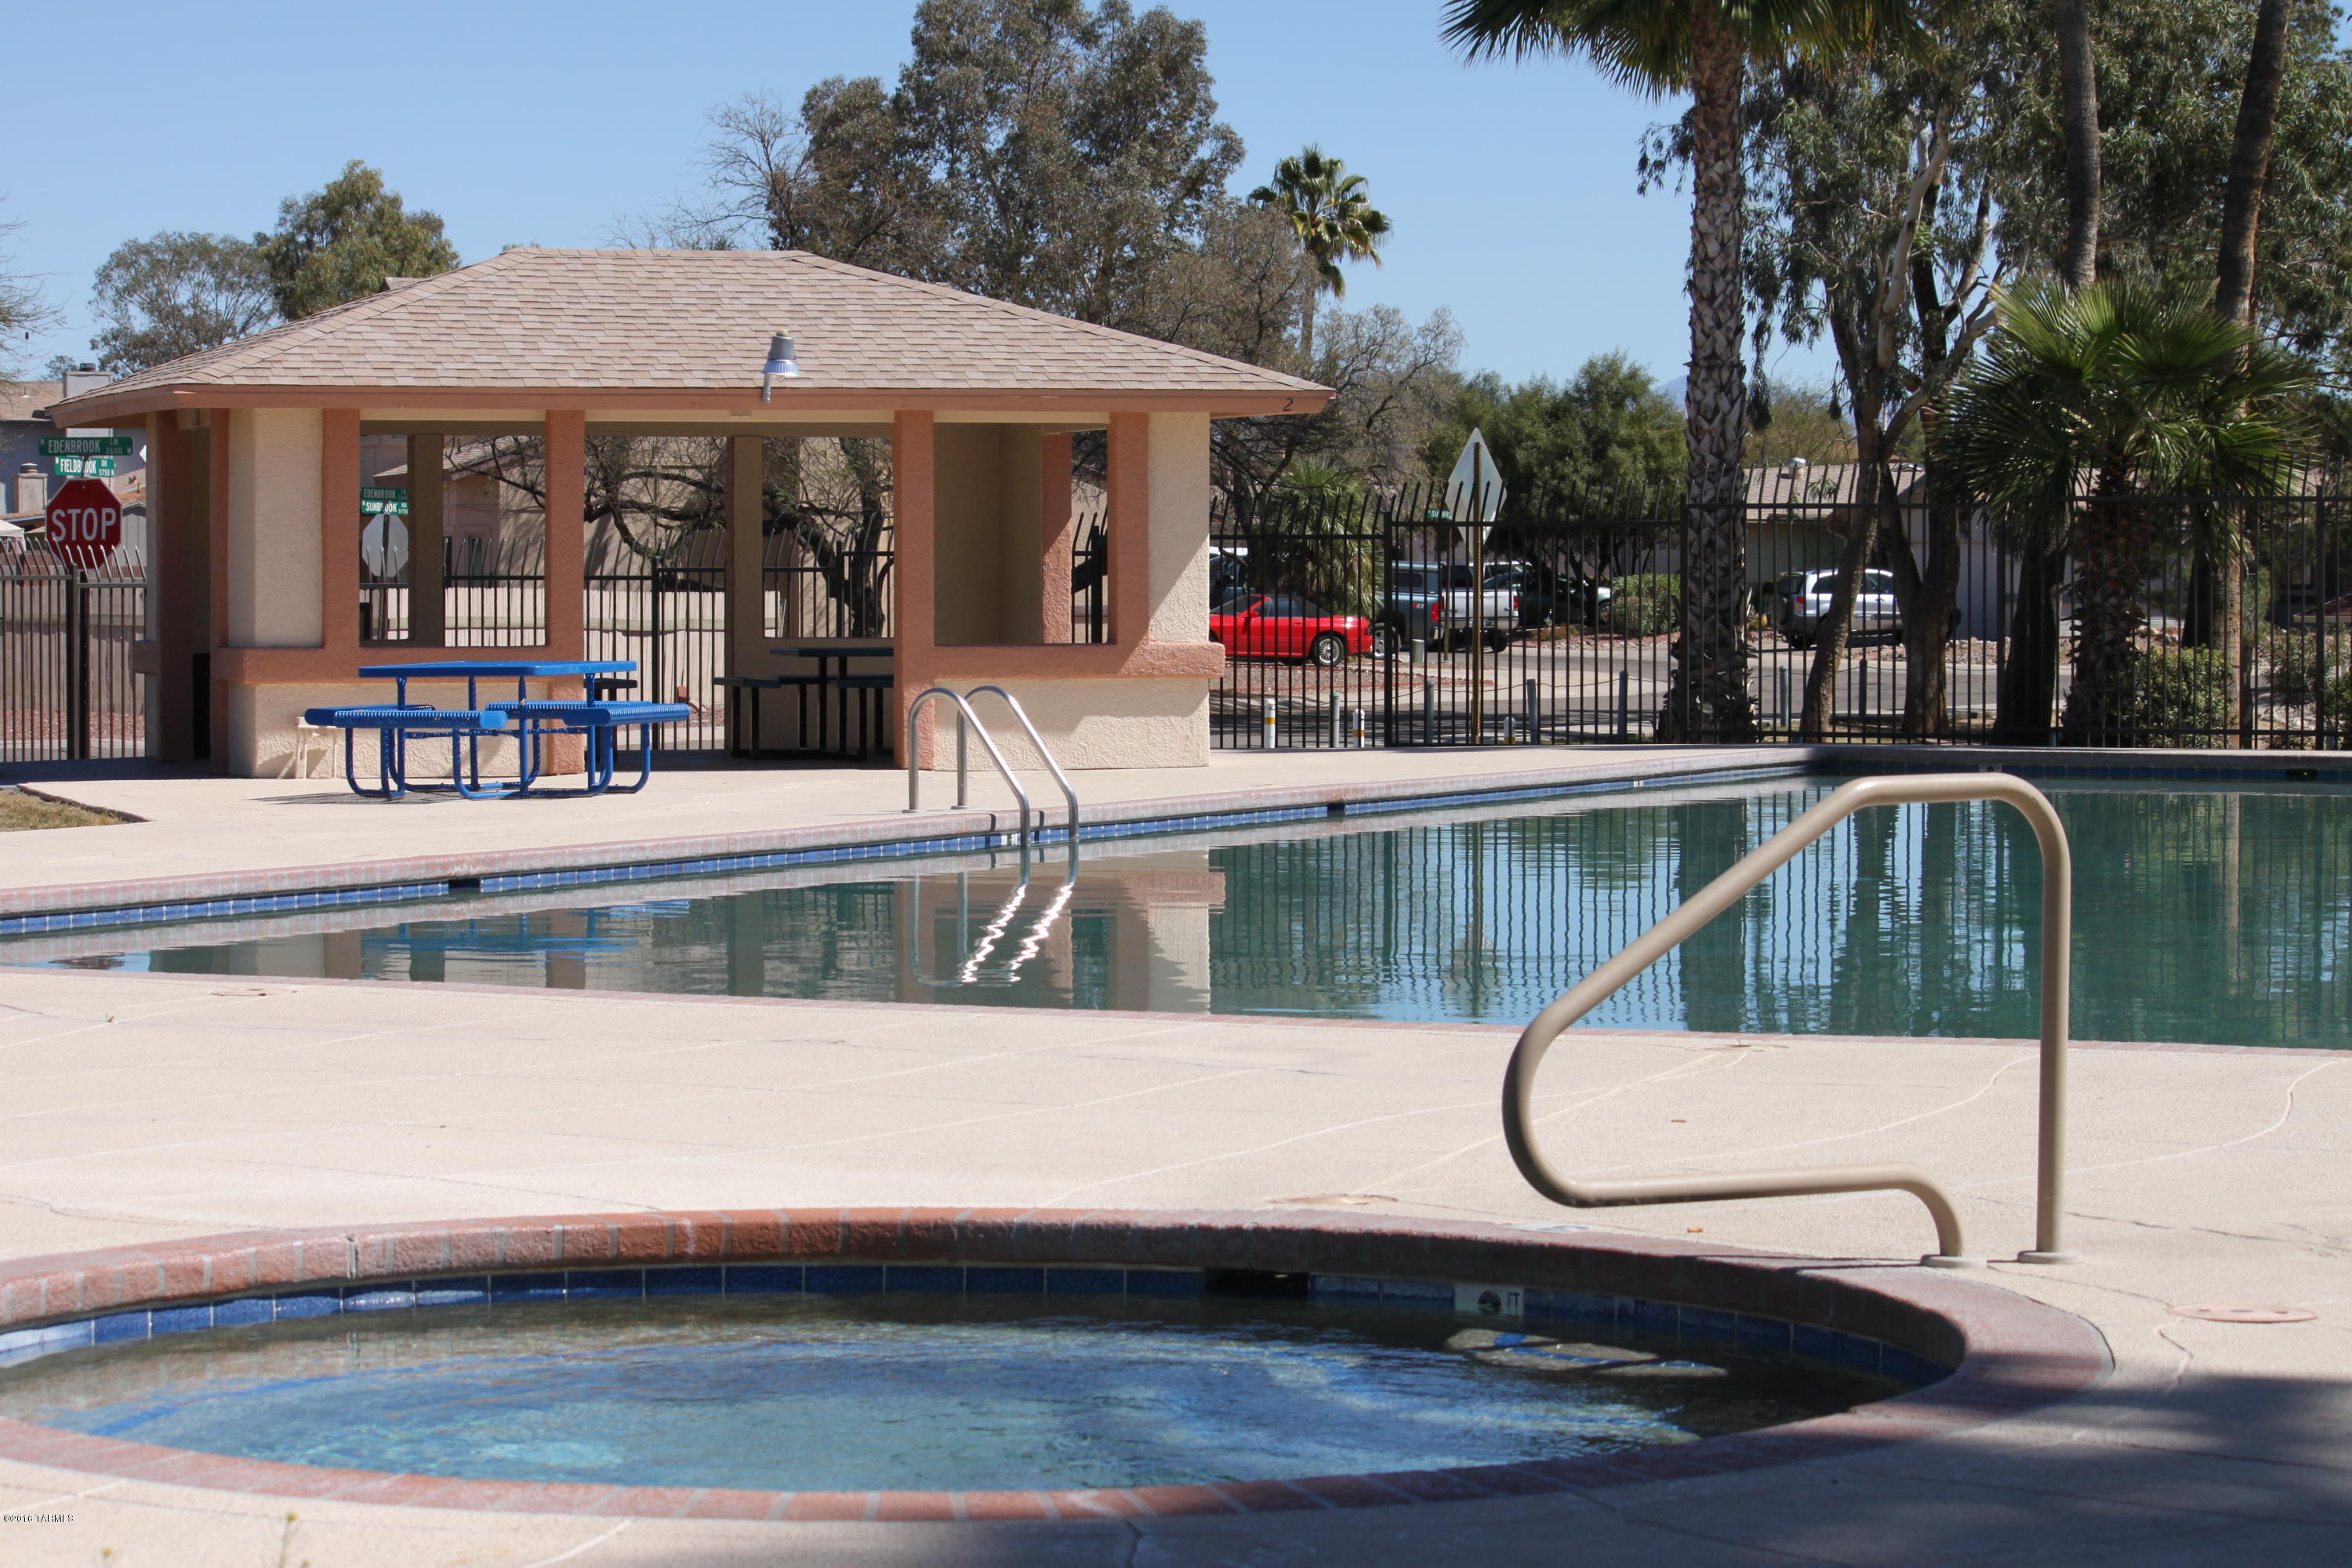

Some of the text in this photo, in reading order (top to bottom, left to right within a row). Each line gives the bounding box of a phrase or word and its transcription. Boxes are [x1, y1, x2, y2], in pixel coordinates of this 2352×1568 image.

[1283, 397, 1294, 412] 2
[48, 439, 101, 453] EDENBROOK
[60, 459, 97, 474] FIELDBOOK
[364, 489, 396, 499] EDENBROOK
[1431, 510, 1453, 519] SUBRO
[51, 508, 117, 542] STOP
